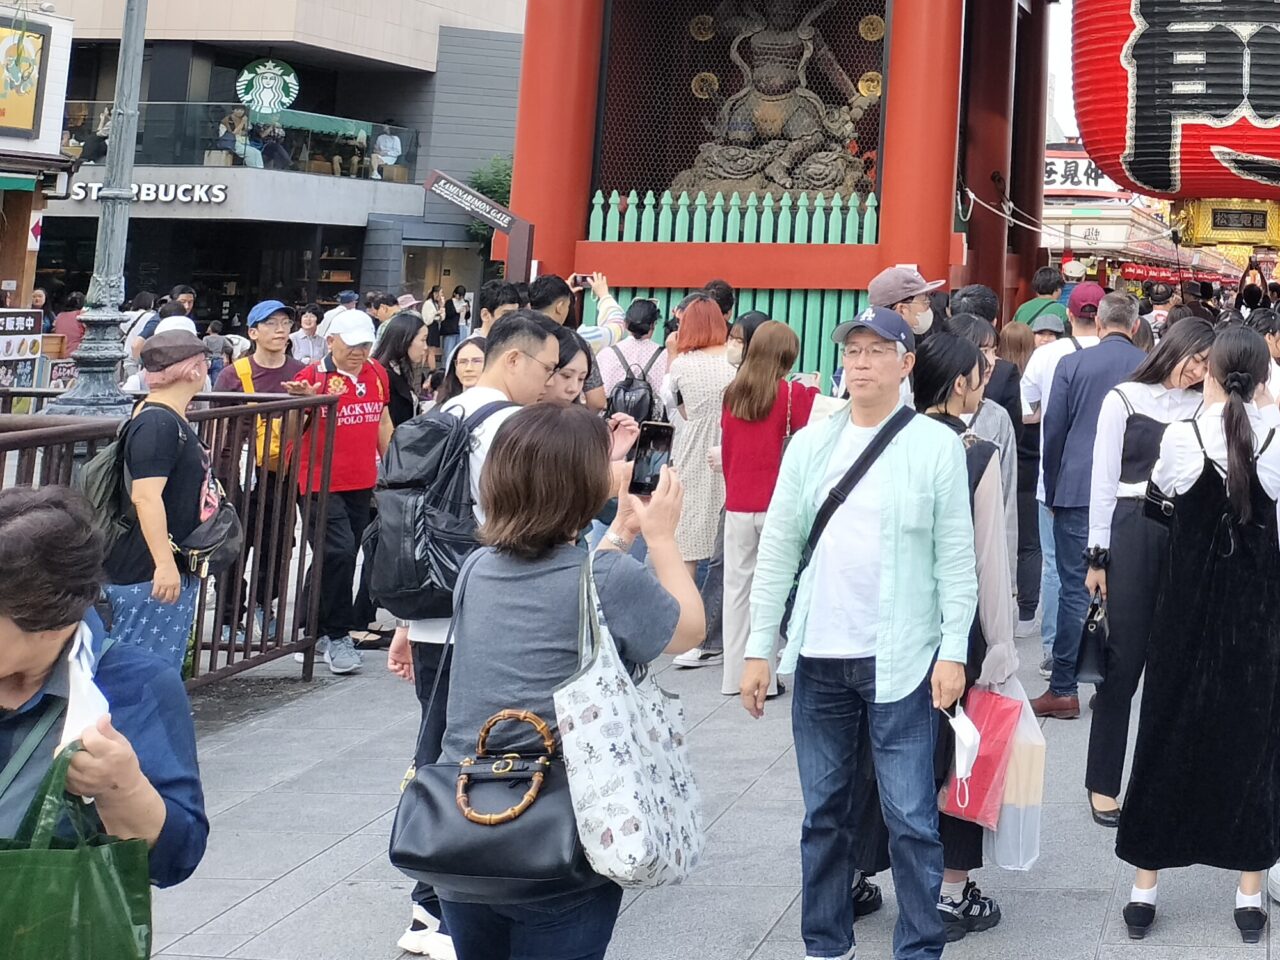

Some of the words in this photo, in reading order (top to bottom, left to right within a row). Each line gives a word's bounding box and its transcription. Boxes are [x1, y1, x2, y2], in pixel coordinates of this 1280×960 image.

[71, 182, 228, 203] STRBUCKS
[439, 179, 492, 215] KAMINARIMON
[490, 208, 512, 224] GATE
[337, 415, 363, 426] POLO
